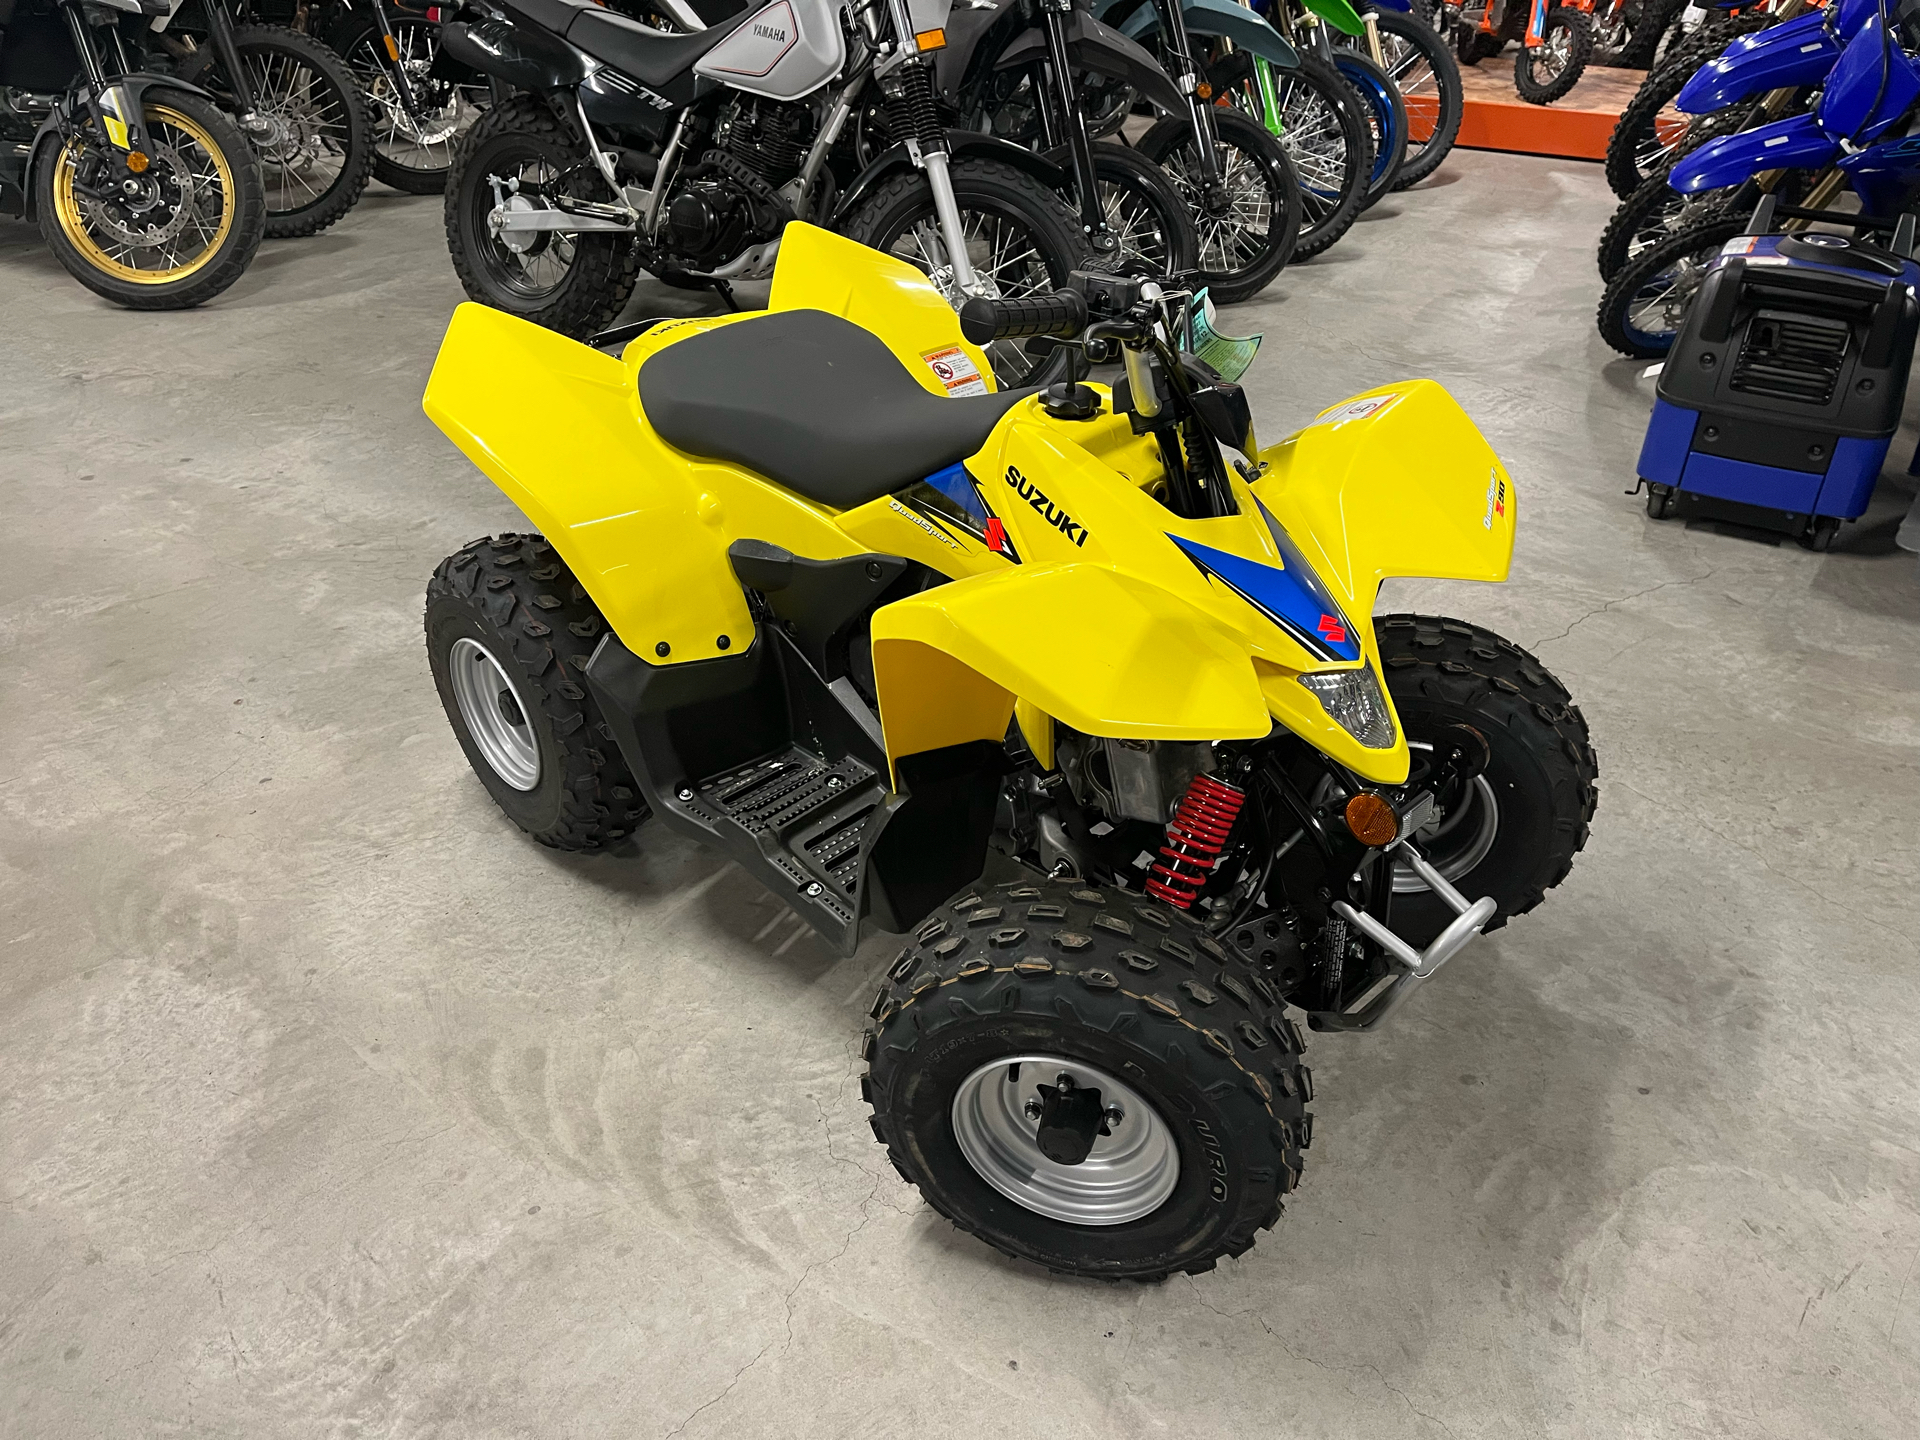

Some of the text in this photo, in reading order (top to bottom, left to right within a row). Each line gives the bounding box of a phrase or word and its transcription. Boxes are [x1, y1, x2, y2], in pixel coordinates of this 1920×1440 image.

[753, 23, 786, 43] YAMAHA
[636, 86, 674, 111] TW
[1005, 465, 1089, 548] SUZUKI
[1495, 479, 1506, 518] Z90
[888, 500, 959, 550] QuadSport
[1173, 1092, 1229, 1204] DURO
